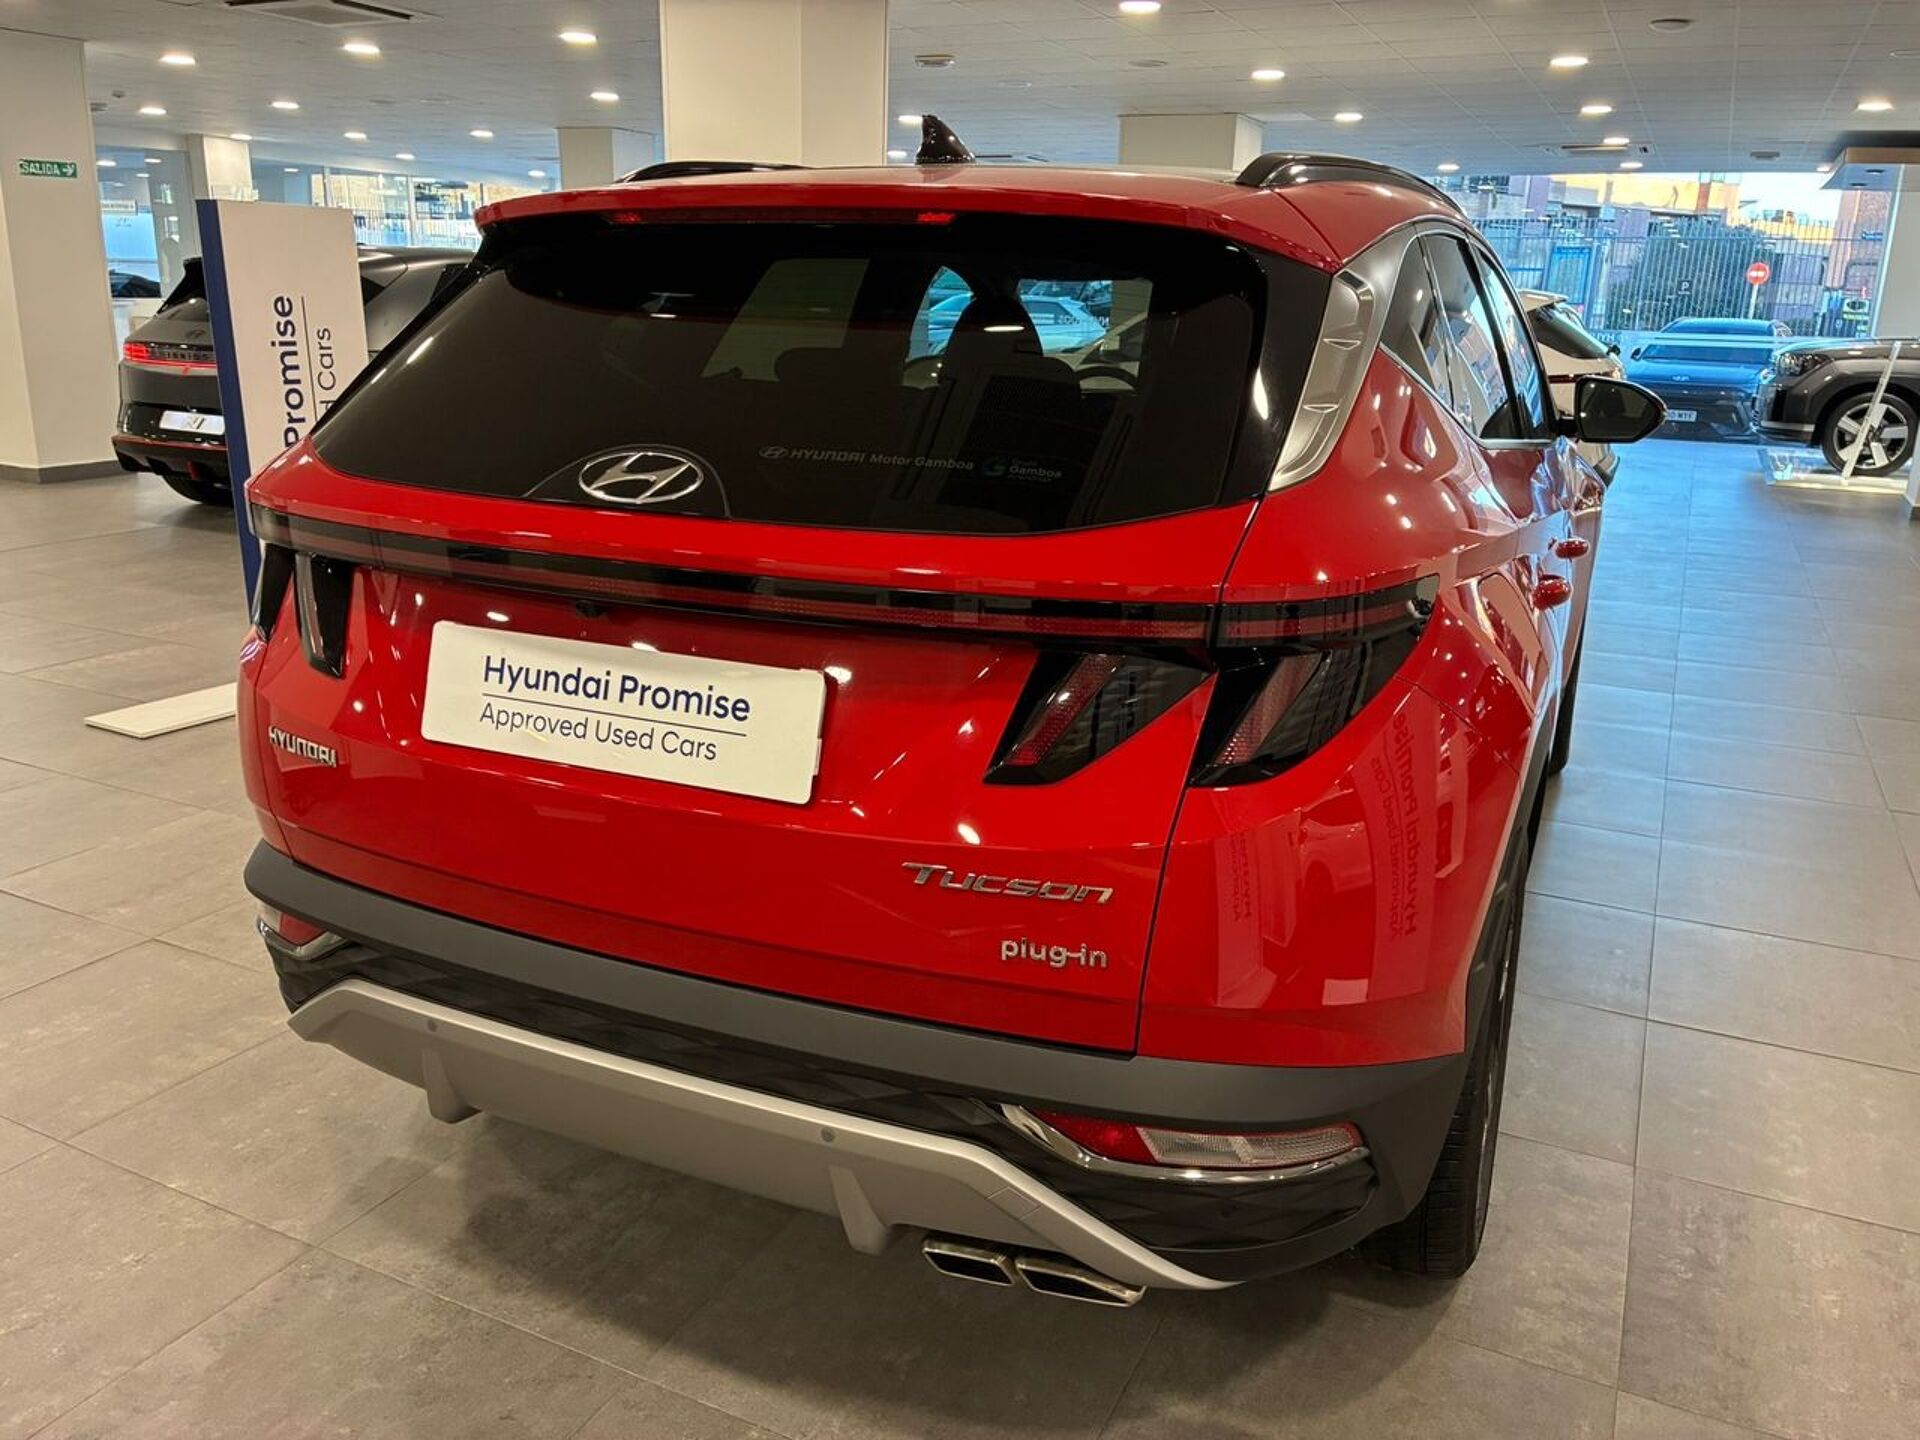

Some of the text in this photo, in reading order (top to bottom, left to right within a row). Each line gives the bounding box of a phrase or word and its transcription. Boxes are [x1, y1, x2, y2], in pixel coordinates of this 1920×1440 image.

[21, 161, 61, 176] SALIDA
[271, 295, 307, 448] Promise
[317, 327, 337, 391] Cars
[790, 449, 975, 470] HYUNDAI Motor Gamboa
[483, 655, 751, 722] Hyundai Promise
[268, 725, 337, 768] HYUNDAI
[480, 702, 717, 760] Approved Used Cars
[1001, 937, 1108, 968] plug-in
